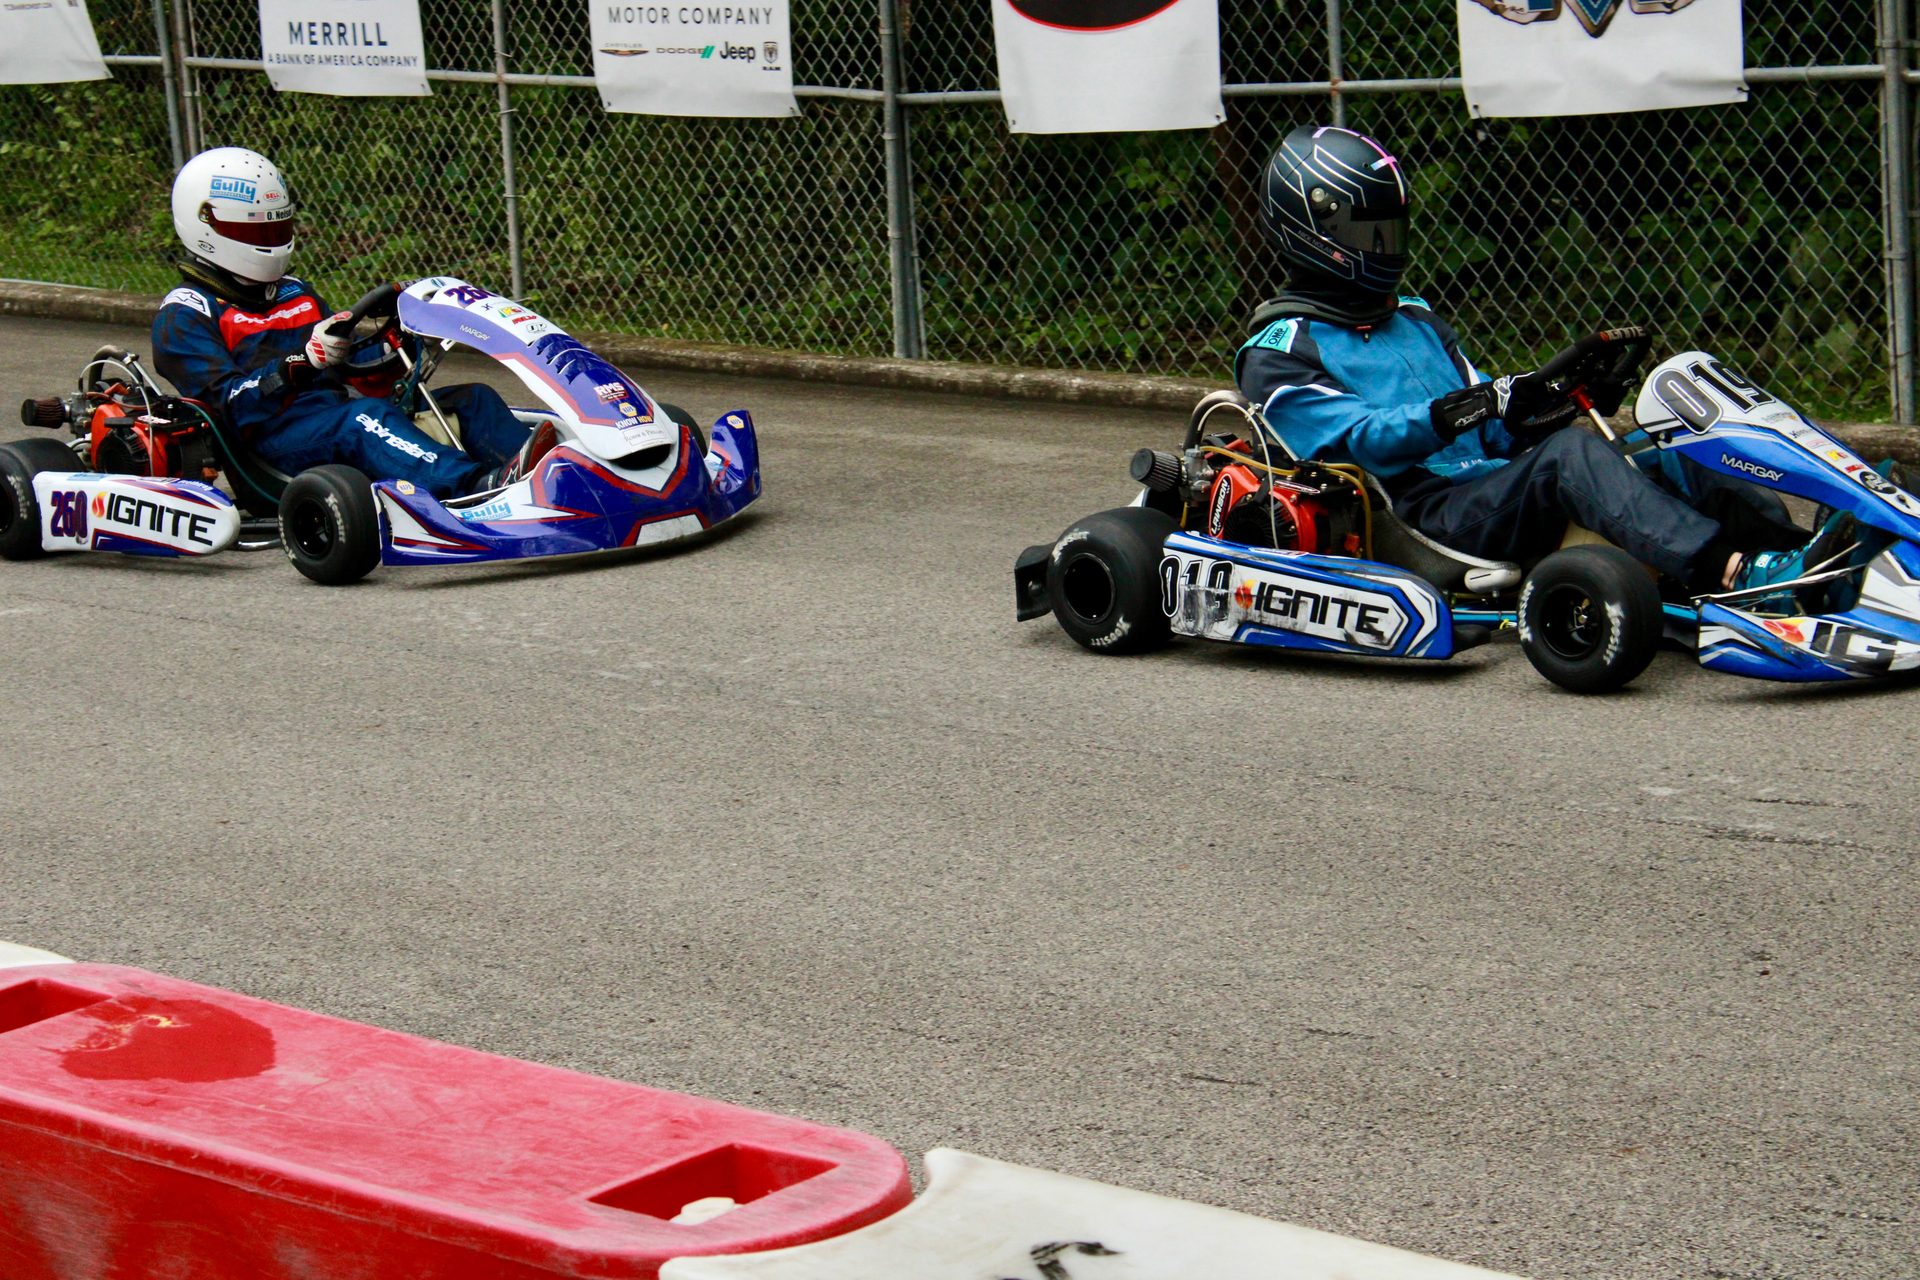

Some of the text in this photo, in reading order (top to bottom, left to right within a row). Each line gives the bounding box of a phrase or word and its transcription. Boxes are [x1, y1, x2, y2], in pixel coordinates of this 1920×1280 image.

[608, 7, 773, 25] MOTOR COMPANY
[289, 21, 388, 46] MERRILL
[268, 54, 418, 67] A BANK OF AMERICA COMPANY
[720, 41, 756, 63] Jeep
[211, 178, 256, 200] Gully
[460, 324, 490, 341] MARGAY
[1268, 326, 1285, 346] OMP
[593, 382, 624, 396] RMS
[615, 415, 653, 429] KNOW HOW
[356, 413, 438, 464] alpinestars
[1721, 453, 1784, 481] MARGAY
[460, 501, 511, 521] Gully
[1211, 478, 1229, 535] LAWSON
[50, 490, 216, 546] 260 IGNITE
[1254, 581, 1389, 635] IGNITE
